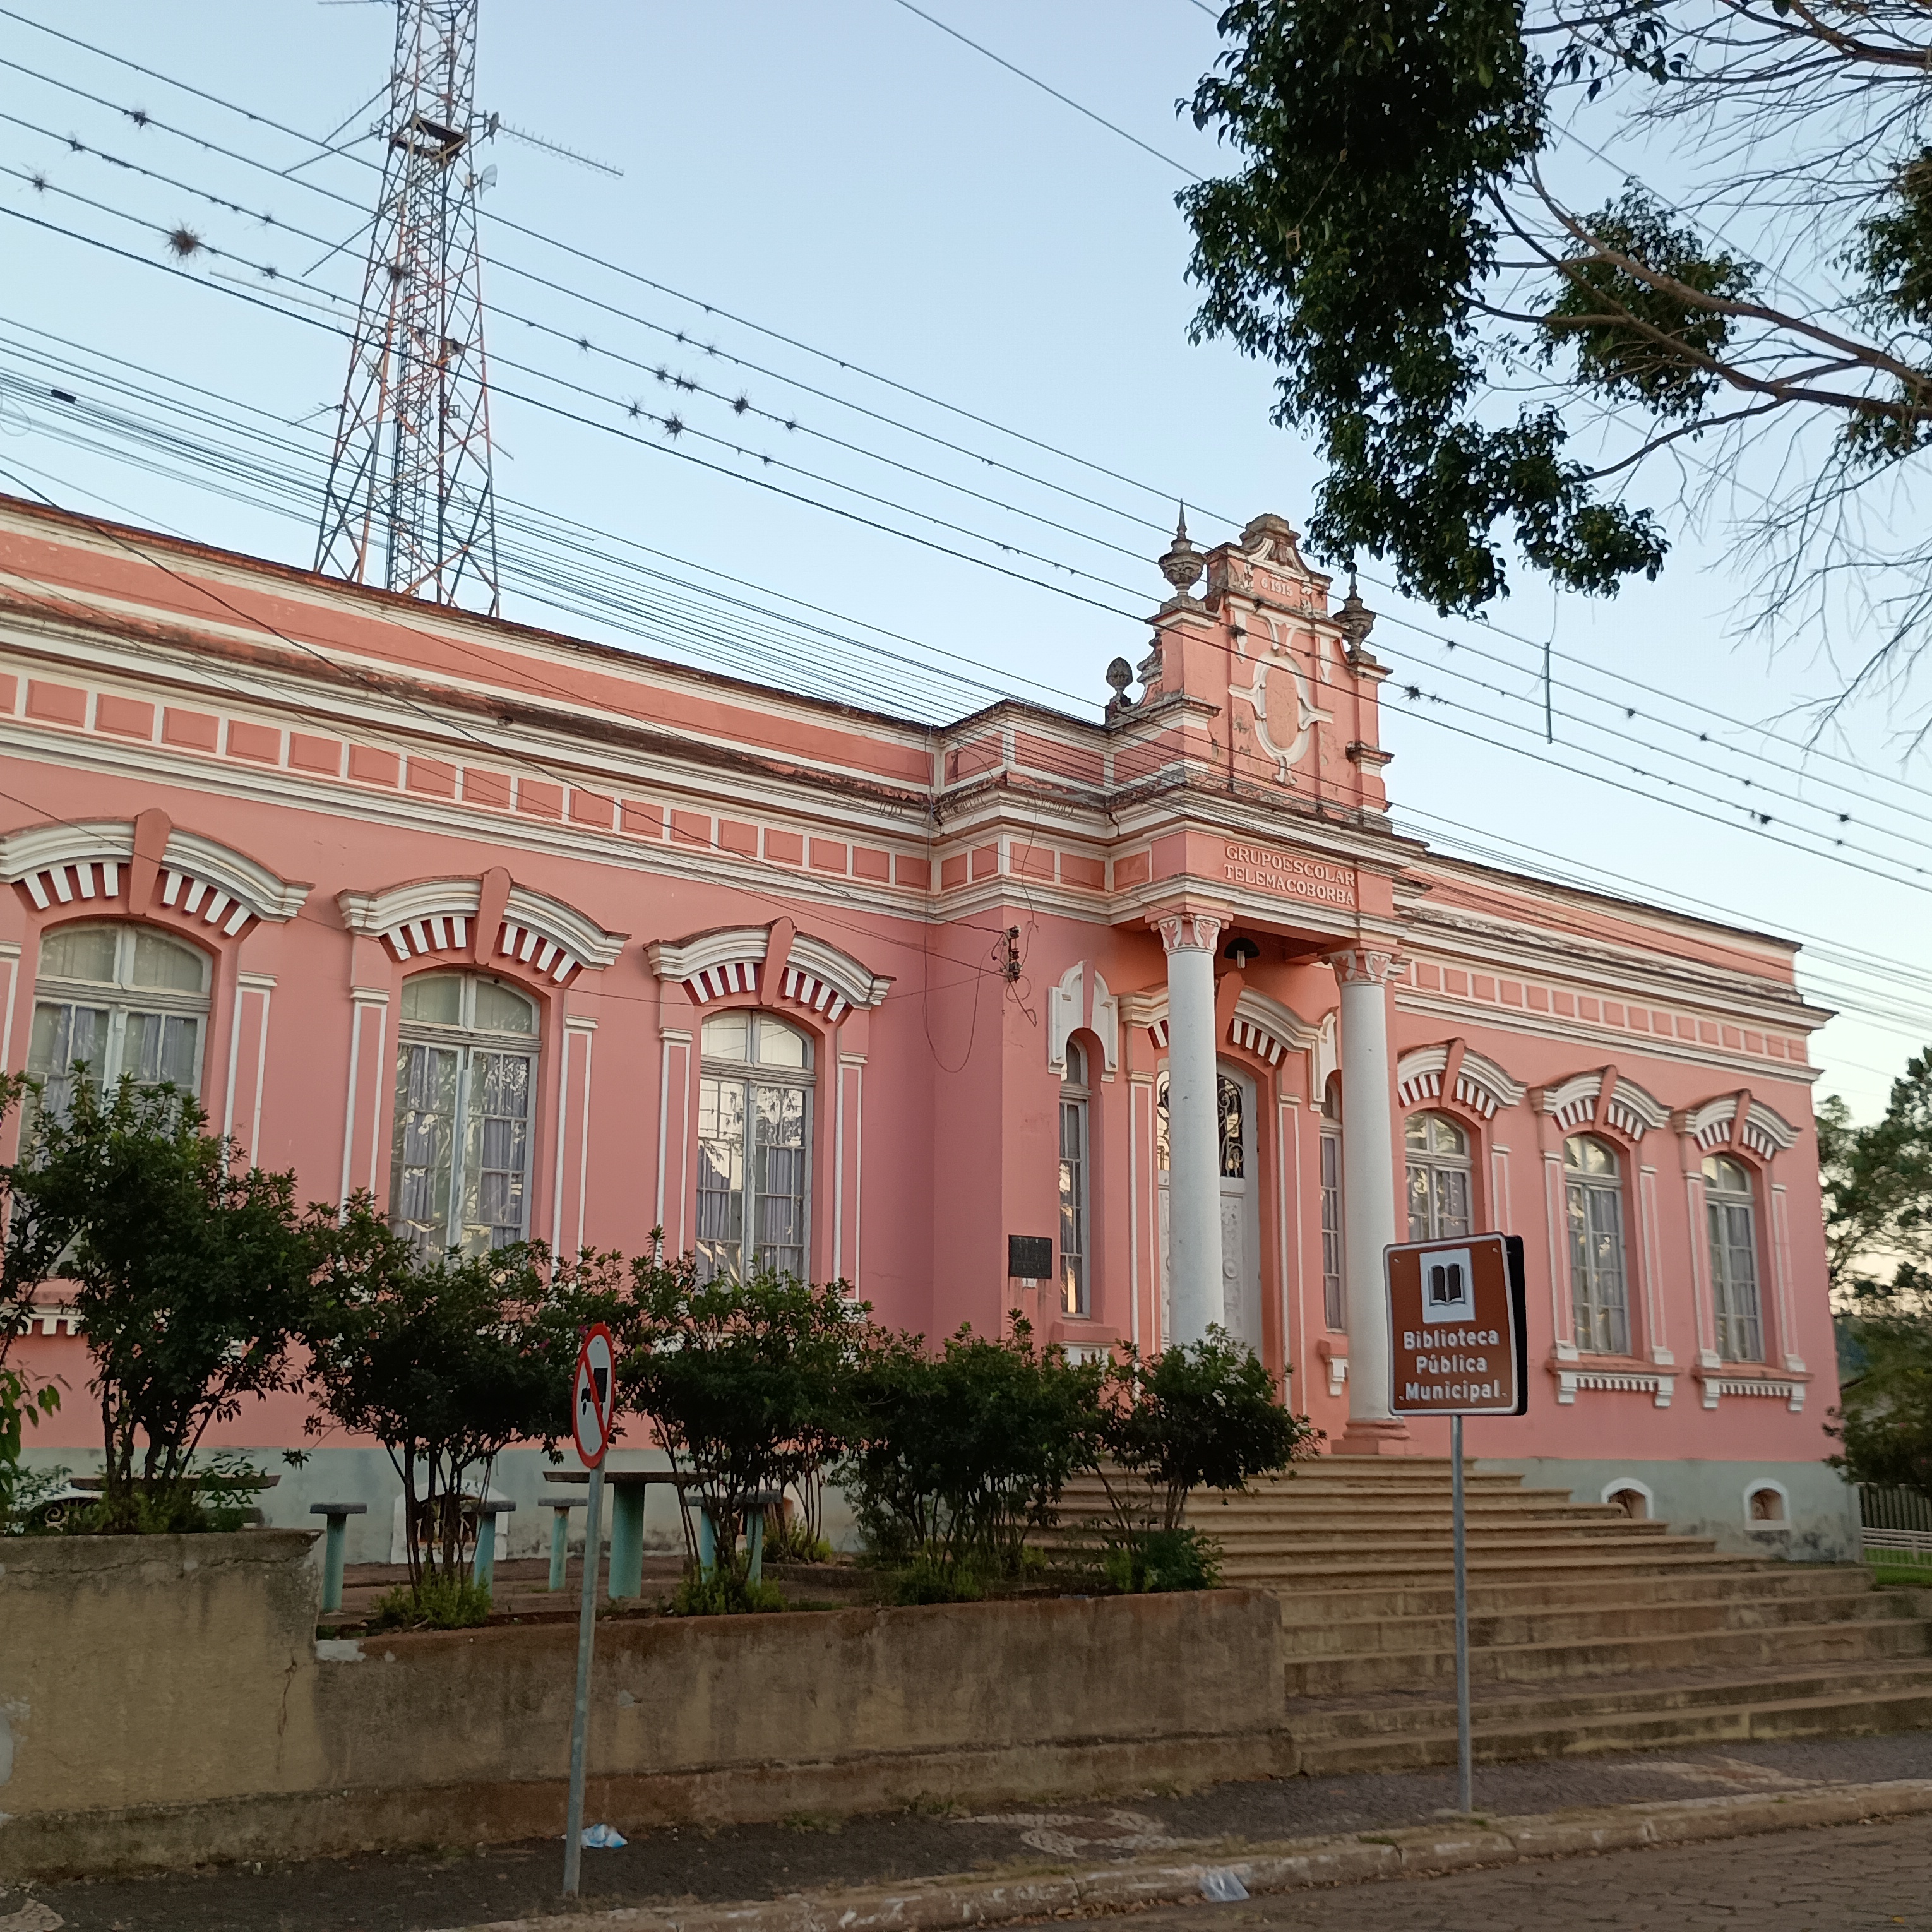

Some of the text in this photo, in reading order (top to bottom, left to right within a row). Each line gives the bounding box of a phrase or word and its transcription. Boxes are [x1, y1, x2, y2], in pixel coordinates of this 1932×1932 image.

[1404, 1328, 1499, 1350] Biblioteca
[1416, 1354, 1488, 1374] Pública
[1405, 1379, 1500, 1404] Municipal
